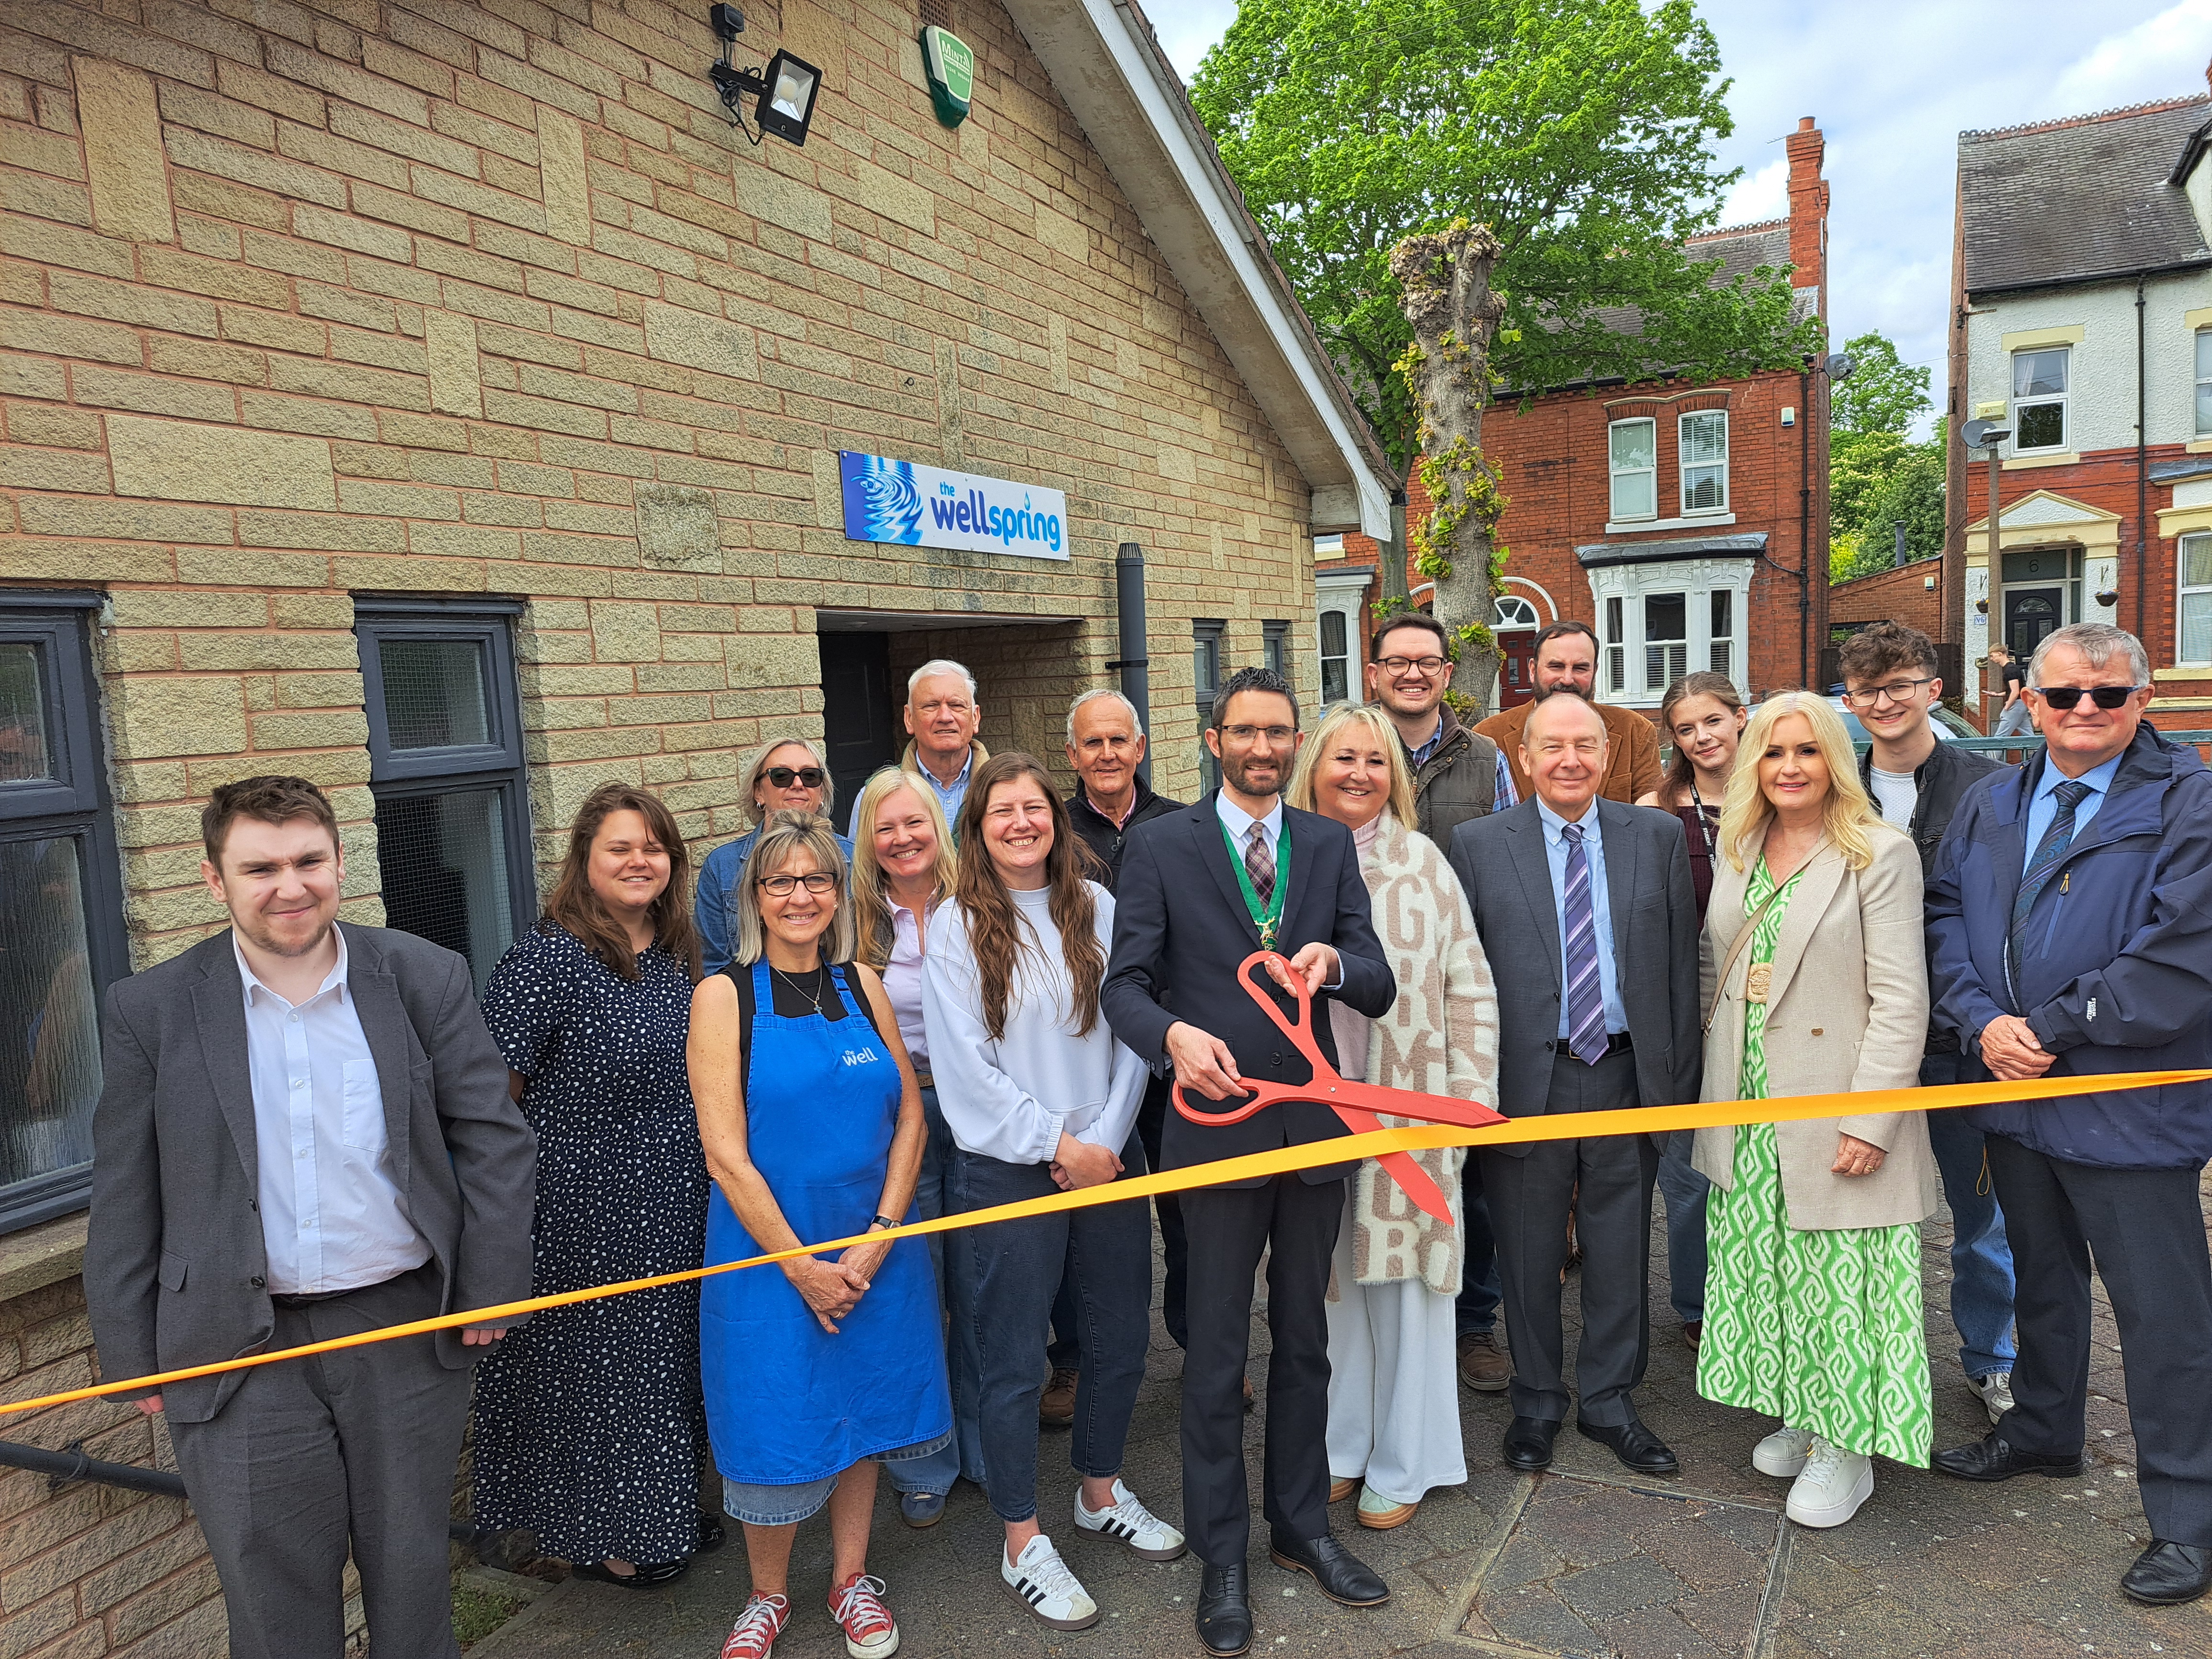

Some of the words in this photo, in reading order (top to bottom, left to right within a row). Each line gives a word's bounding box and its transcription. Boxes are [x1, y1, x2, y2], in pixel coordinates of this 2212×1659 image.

[942, 40, 963, 64] MINT
[940, 481, 955, 497] the
[930, 489, 1061, 552] wellspring
[2029, 559, 2039, 572] 6
[1696, 804, 1704, 820] STUDENT
[1703, 827, 1711, 846] STUDENT
[842, 1047, 878, 1066] well
[1025, 1545, 1036, 1559] adidas
